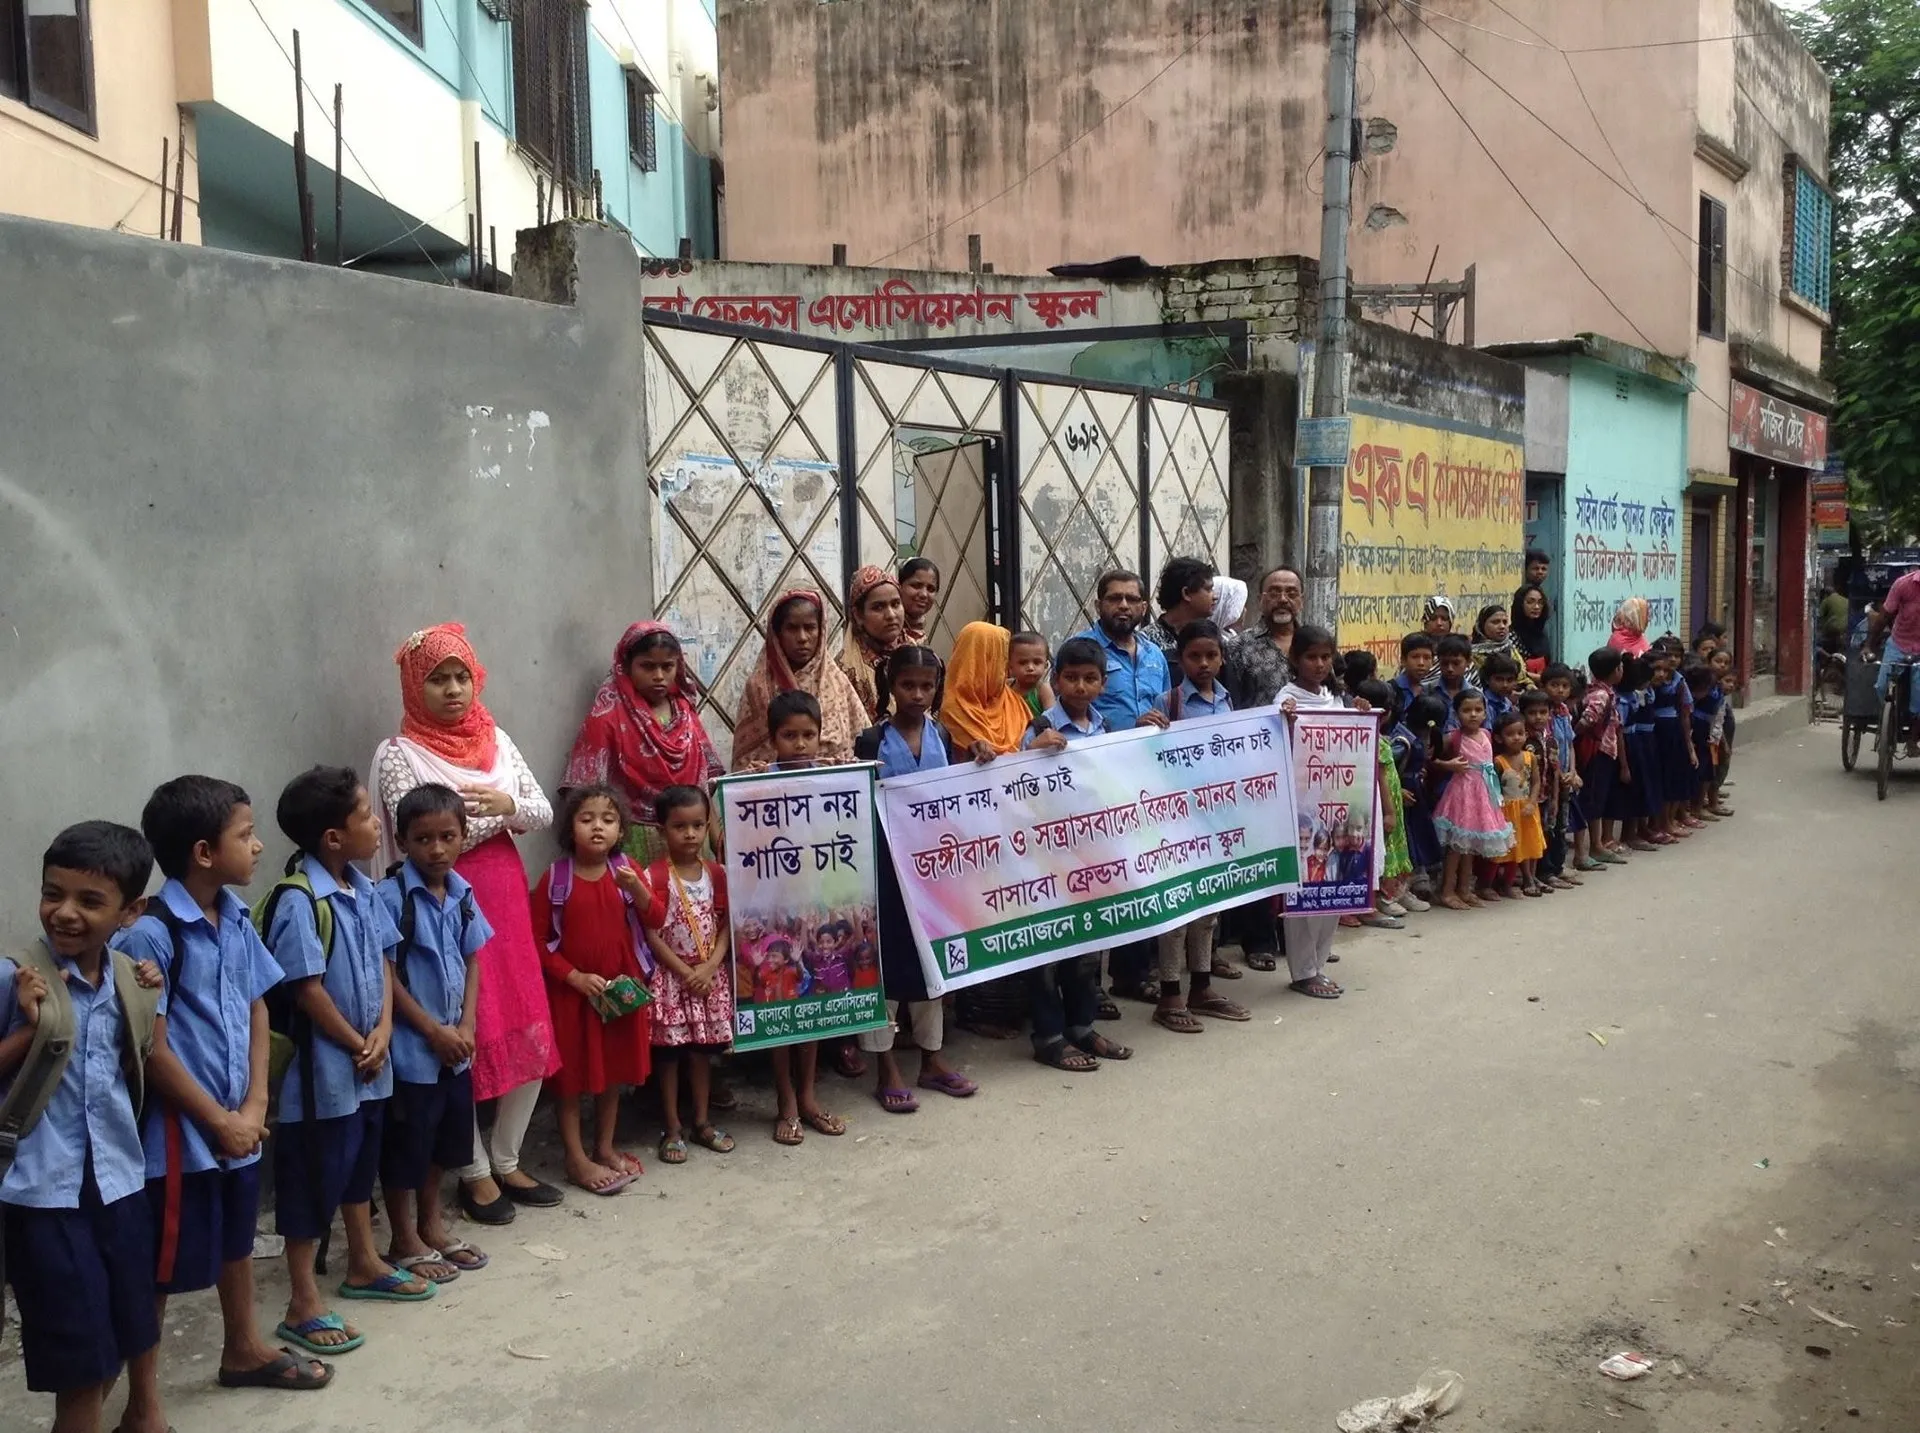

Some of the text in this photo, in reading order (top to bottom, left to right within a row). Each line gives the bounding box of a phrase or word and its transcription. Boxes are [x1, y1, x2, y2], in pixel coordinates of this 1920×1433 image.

[808, 278, 1019, 334] এসোসিয়েশন
[1024, 290, 1105, 328] স্কুল
[1065, 422, 1101, 458] ৬৯/২
[1346, 443, 1403, 528] এফ
[1405, 451, 1430, 530] এ
[1576, 484, 1598, 532] সাইন
[1599, 492, 1618, 531] বোর্ড
[1574, 533, 1617, 581] ডিজিটাল
[1156, 726, 1272, 768] শঙ্কামুক্ত জীবন চাই
[1300, 723, 1372, 752] সন্ত্রাসবাদ
[908, 765, 1076, 822] সন্ত্রাস নয়, শান্তি চাই
[1306, 754, 1356, 790] নিপাত
[735, 790, 860, 829] সন্ত্রাস নয়
[911, 772, 1278, 880] জঙ্গীবাদ ও সন্ত্রাসবাদের বিরুদ্ধে মানব বন্ধন
[1318, 800, 1349, 828] যাক
[738, 831, 858, 880] শান্তি চাই
[982, 827, 1246, 914] বাসাবো ফ্রেন্ডস এসোসিয়েশন স্কুল
[980, 914, 1076, 956] আয়োজনে
[1097, 891, 1163, 927] বাসাবো
[1163, 881, 1194, 909] ফ্রেন্ডস
[1197, 862, 1278, 897] এসোসিয়েশন
[757, 991, 879, 1022] বাসাবো ফ্রেন্ডস এসোসিয়েশন
